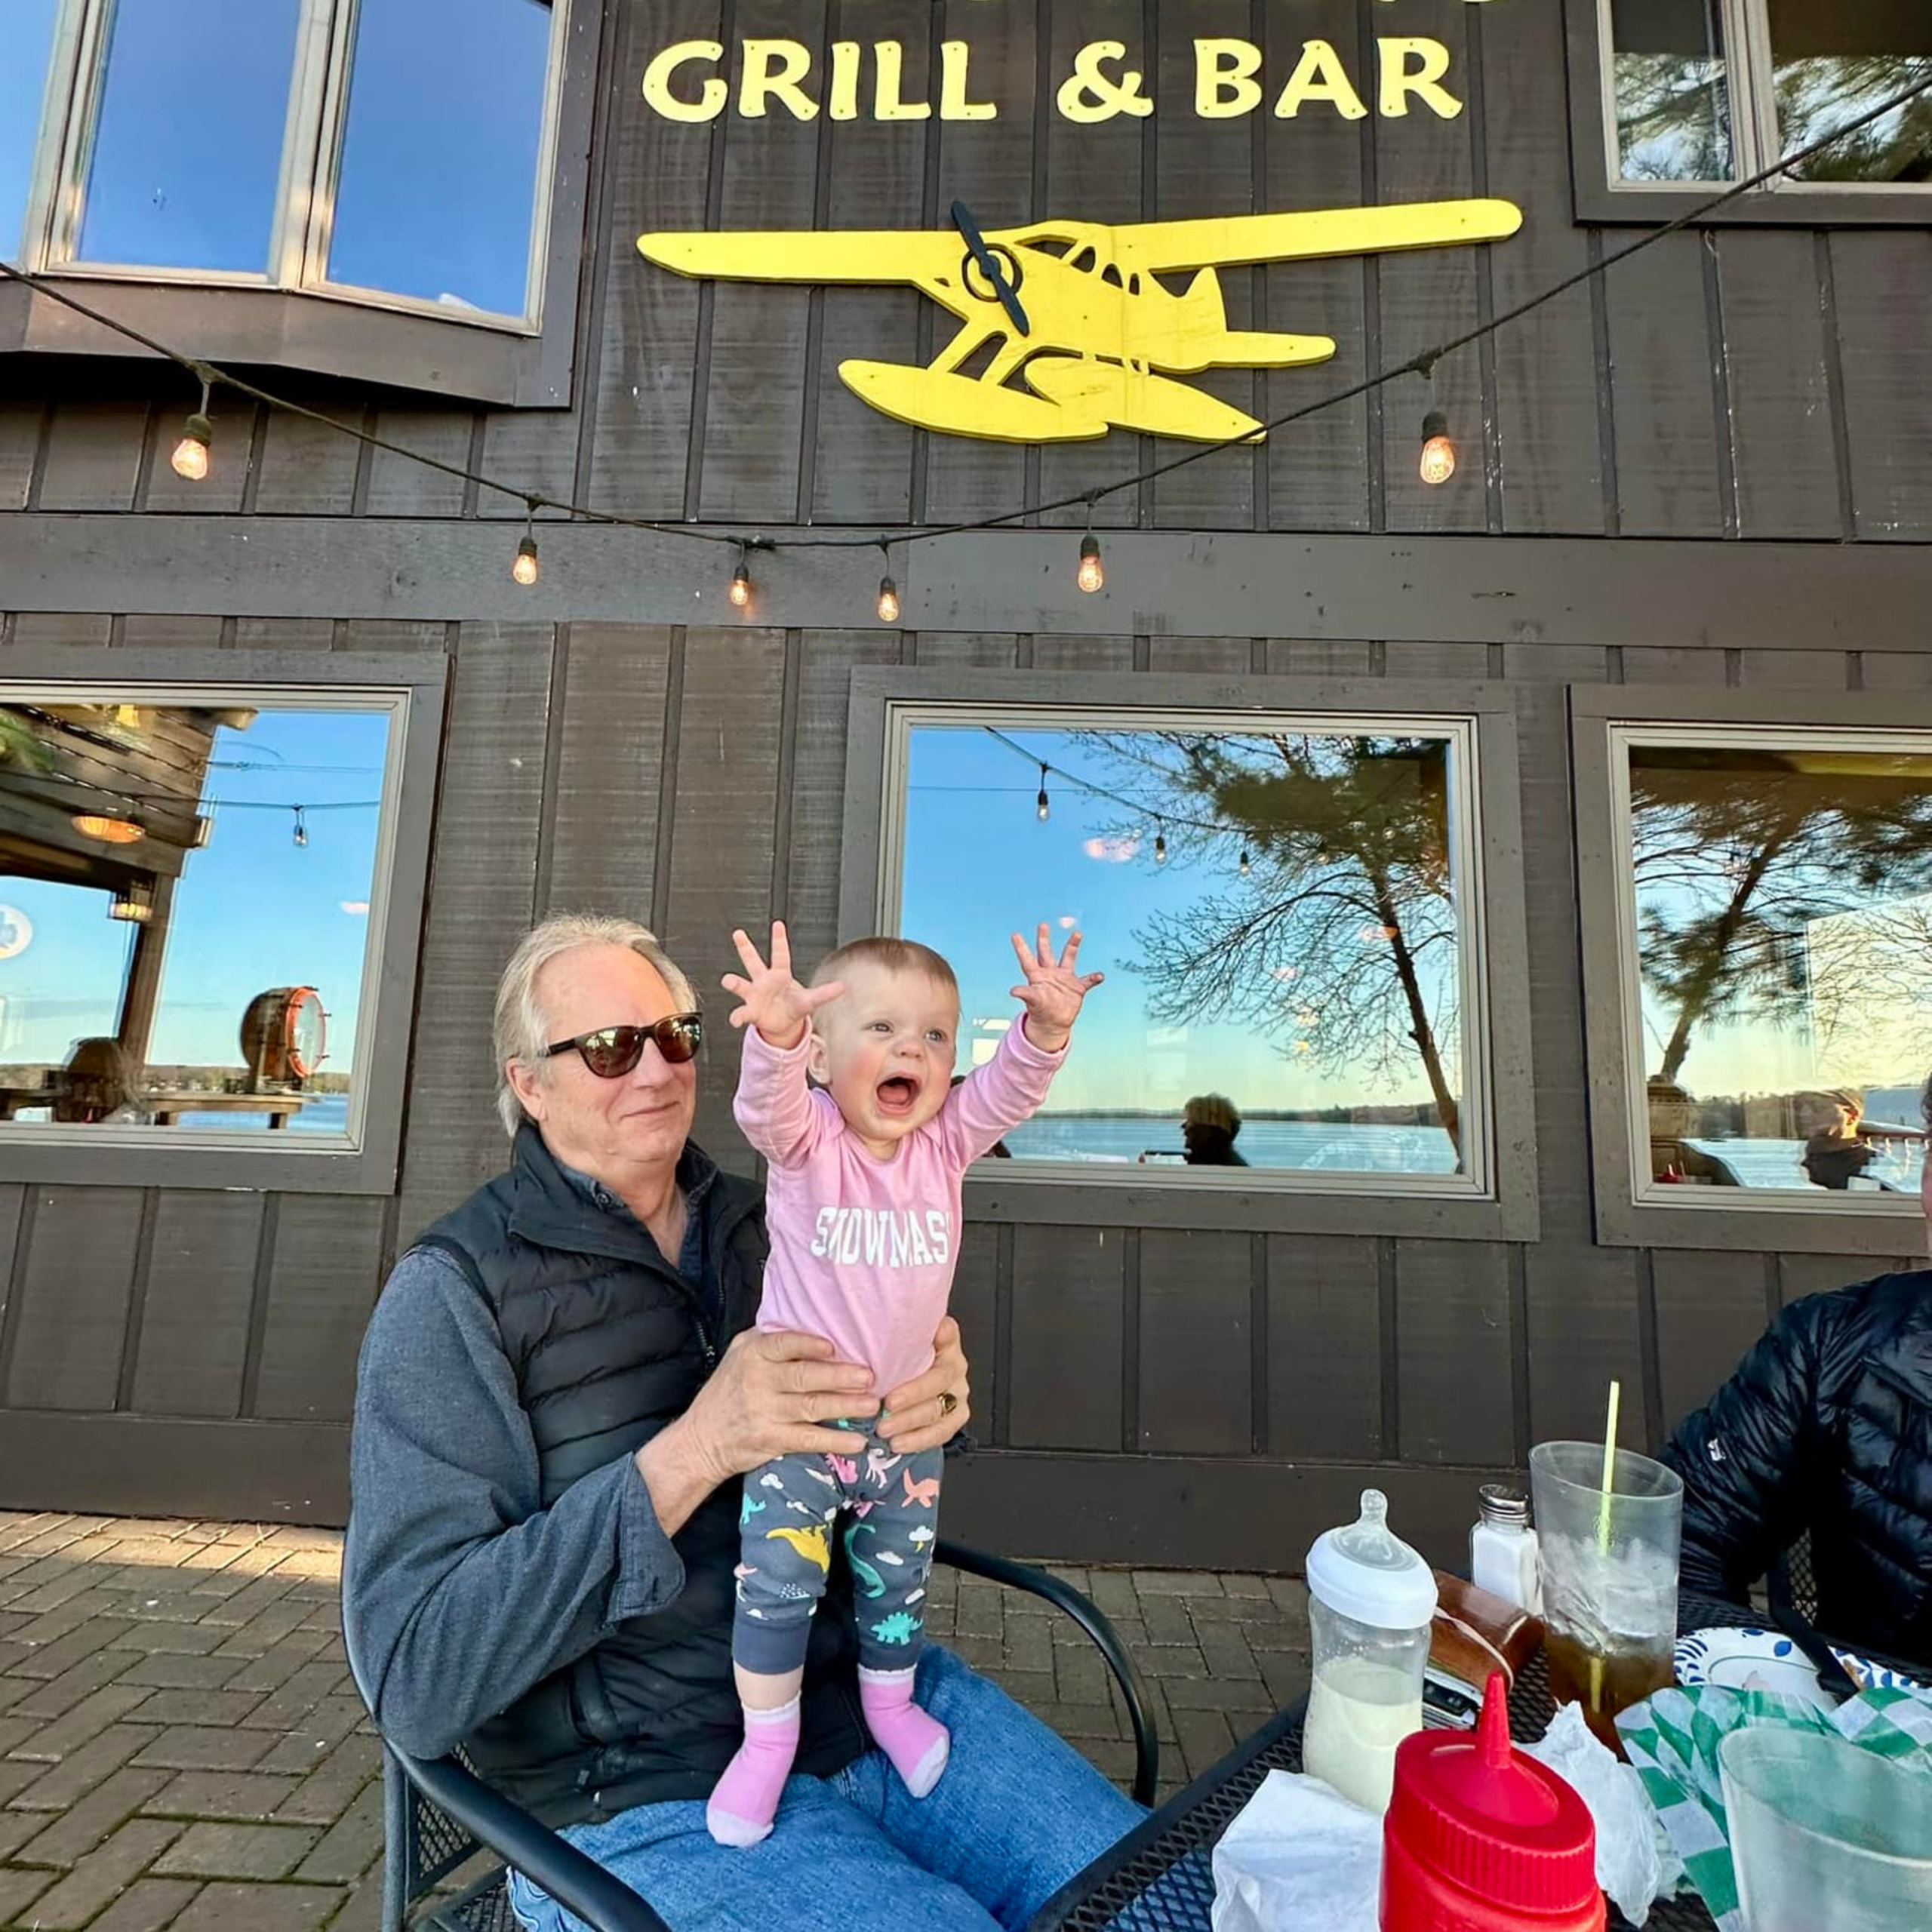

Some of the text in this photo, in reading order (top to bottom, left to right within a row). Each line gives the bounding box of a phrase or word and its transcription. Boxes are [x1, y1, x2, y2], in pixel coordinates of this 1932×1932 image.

[642, 37, 1463, 123] GRILL & BAR
[811, 1207, 950, 1268] SNOWMAS
